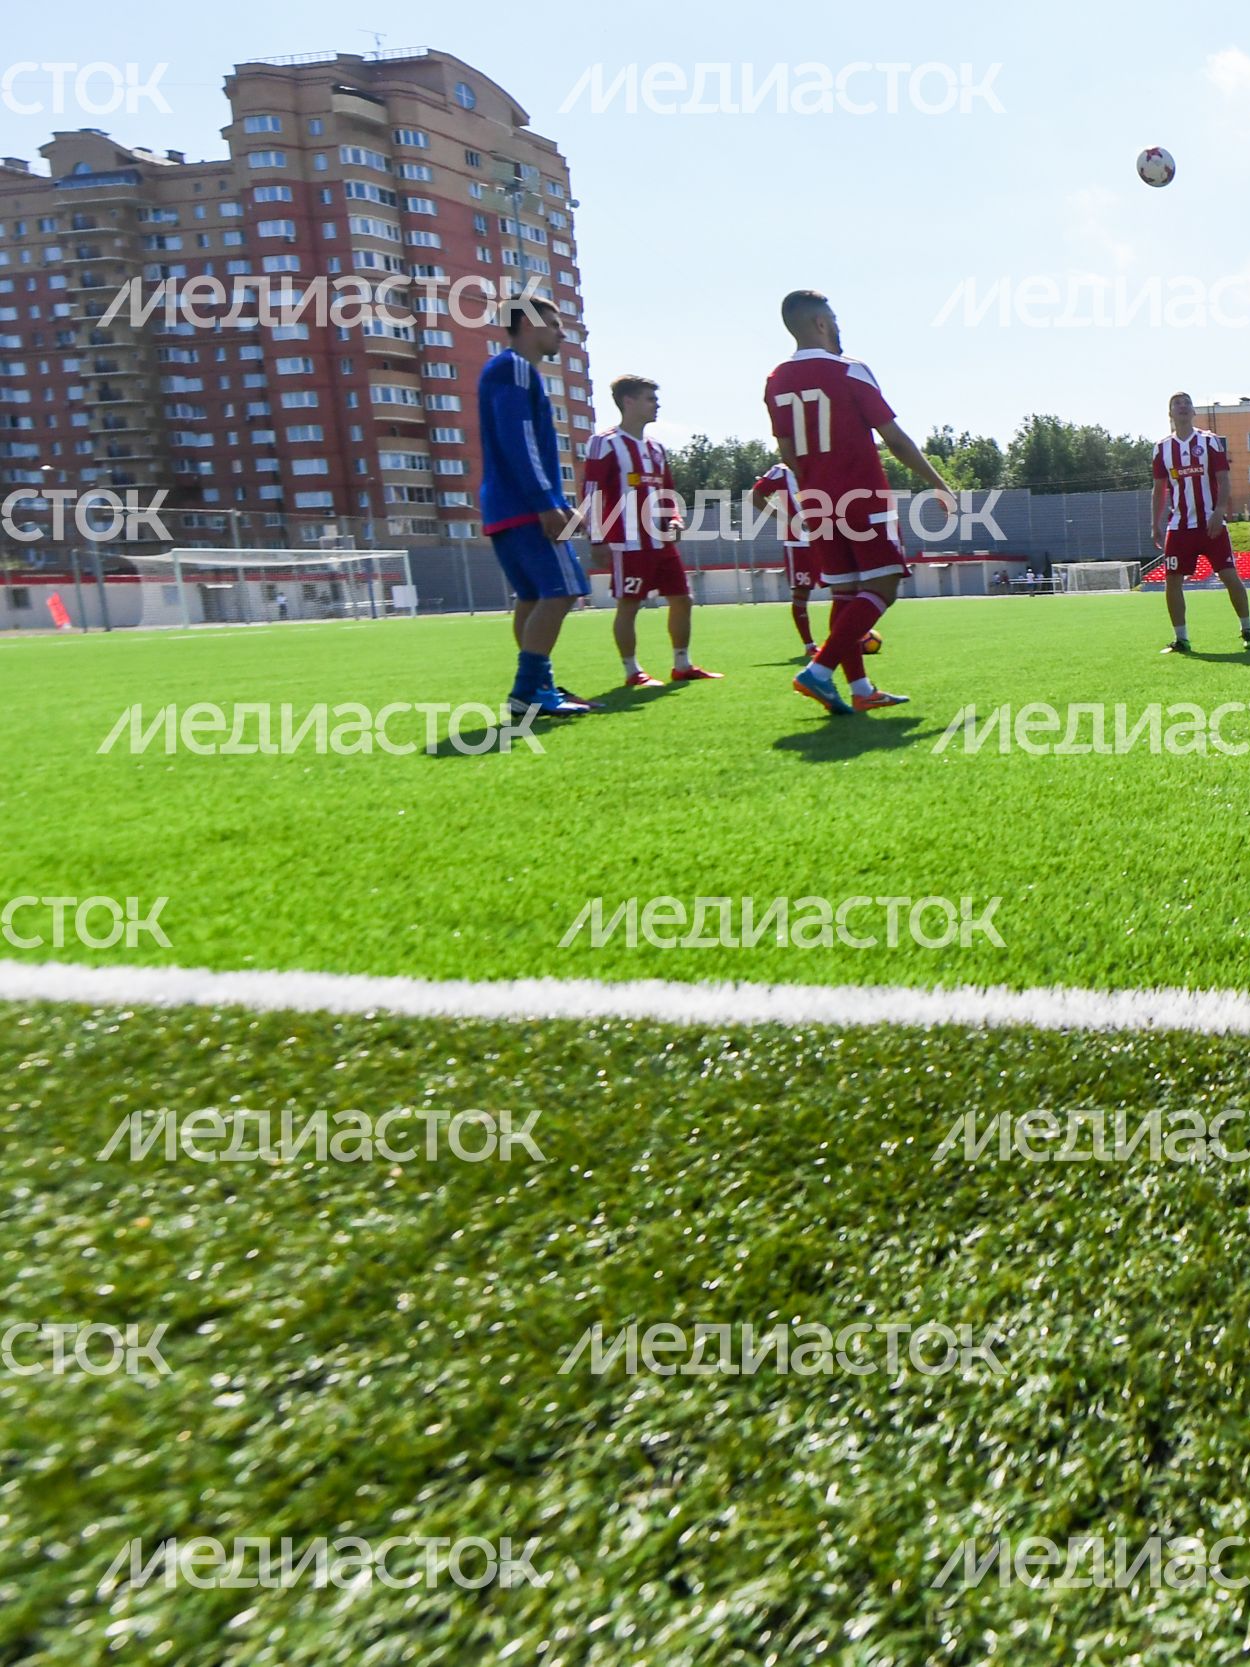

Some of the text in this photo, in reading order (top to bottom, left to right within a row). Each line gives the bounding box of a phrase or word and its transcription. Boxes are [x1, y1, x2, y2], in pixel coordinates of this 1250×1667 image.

[774, 388, 830, 456] 77
[1165, 556, 1178, 570] 19
[623, 576, 642, 594] 27
[795, 571, 811, 586] 96
